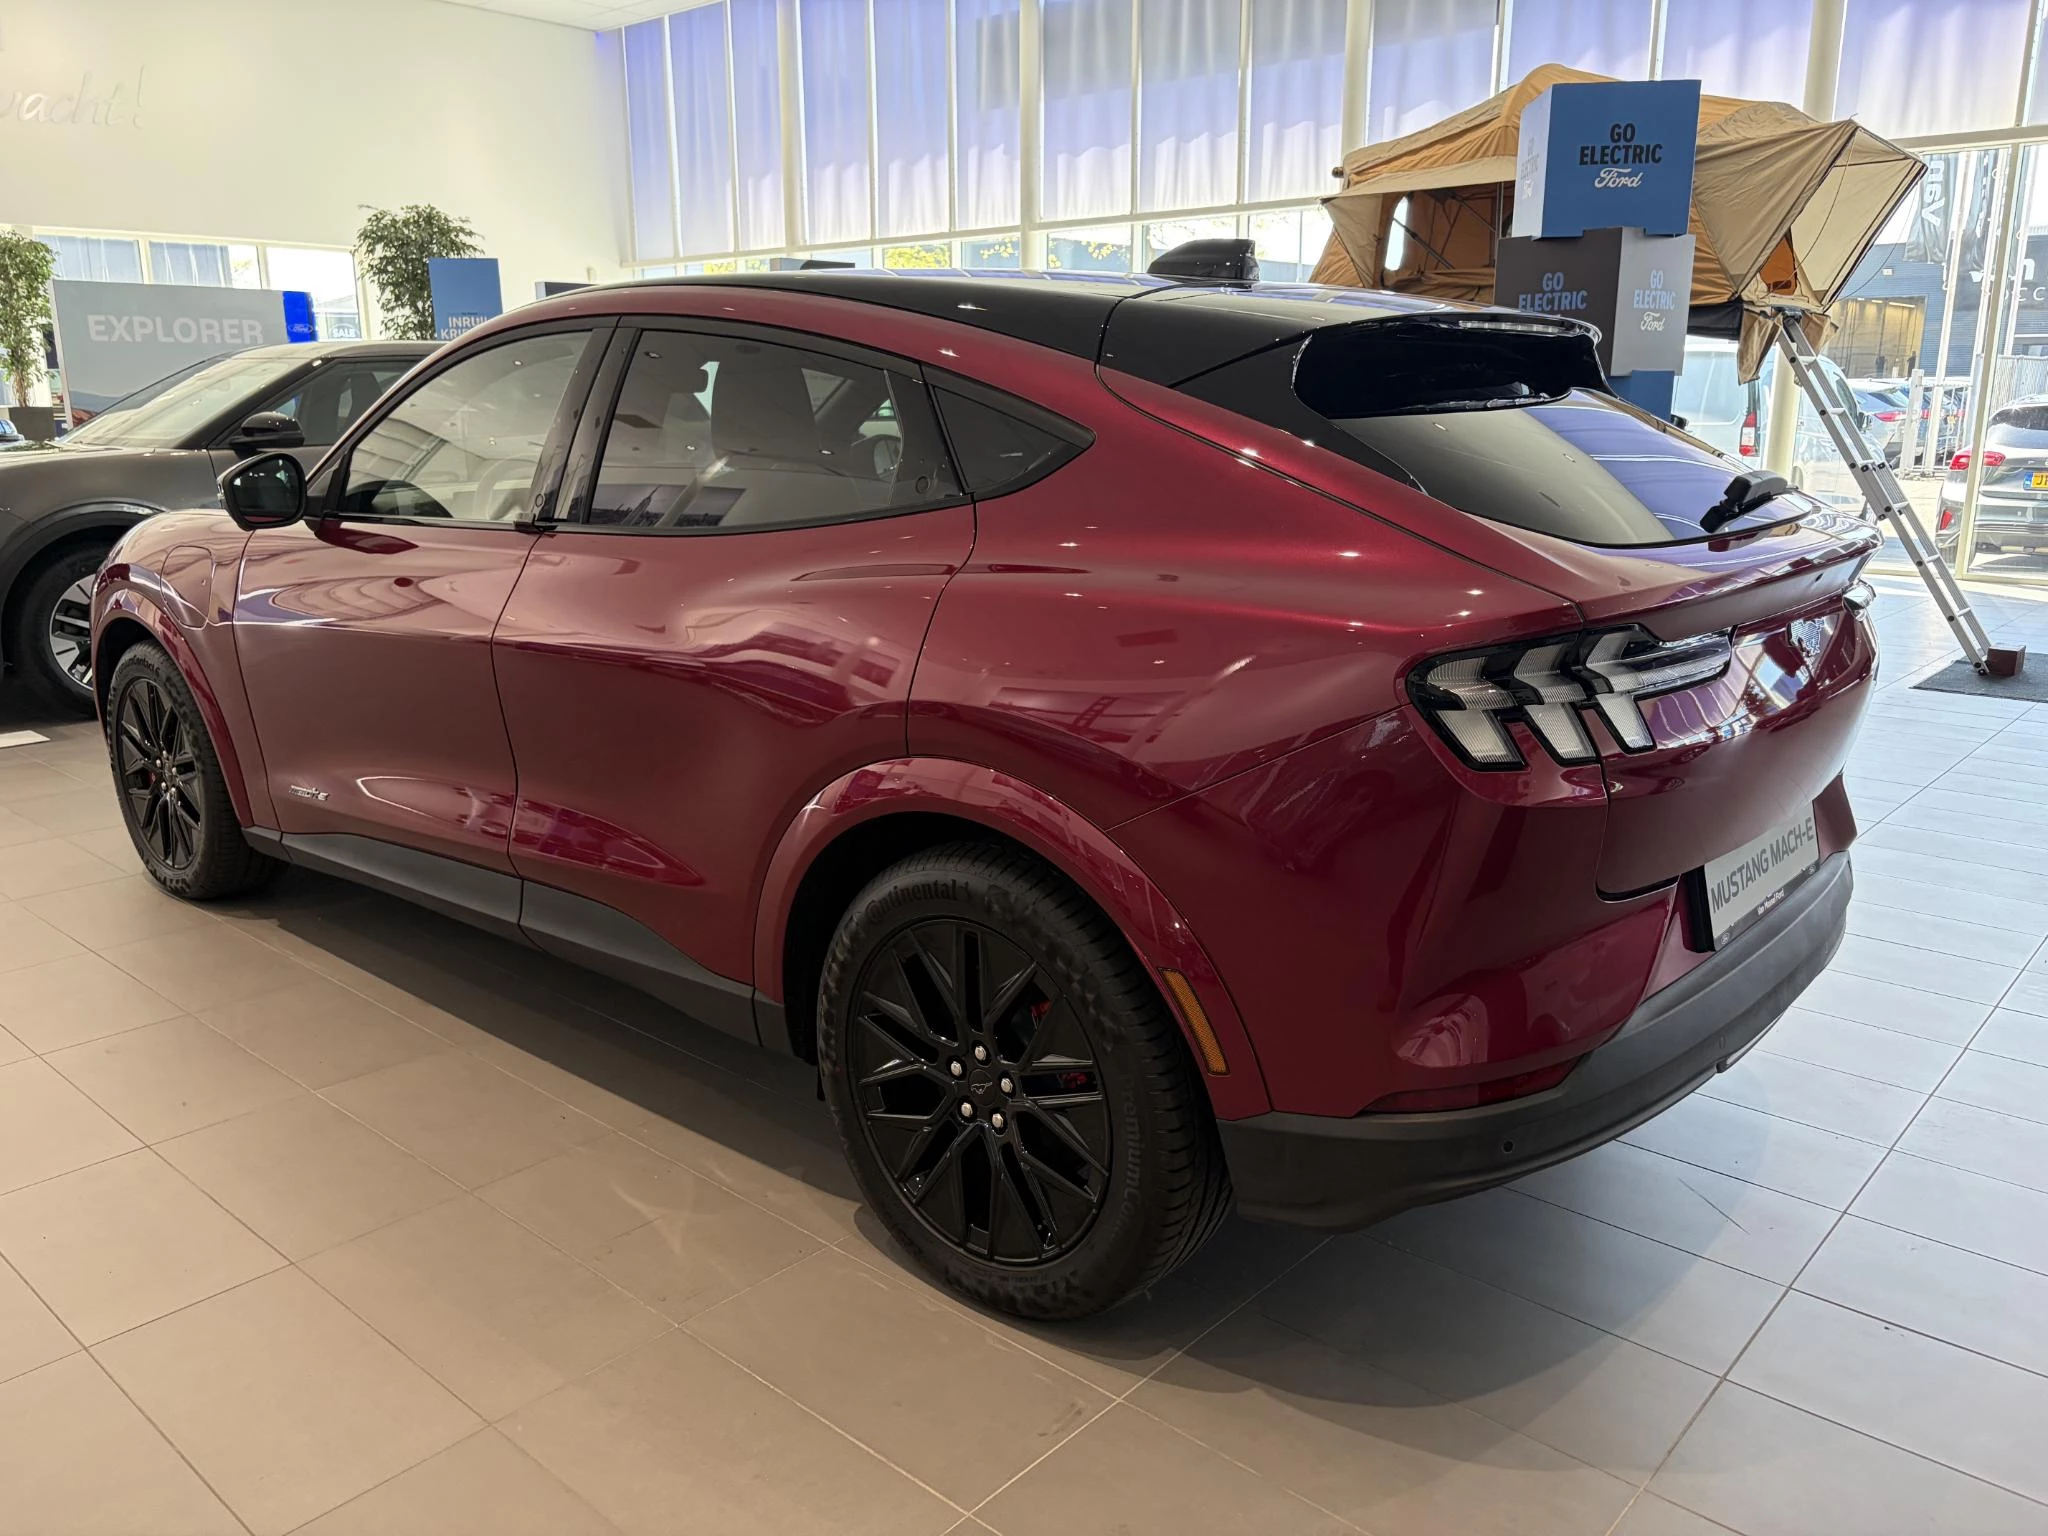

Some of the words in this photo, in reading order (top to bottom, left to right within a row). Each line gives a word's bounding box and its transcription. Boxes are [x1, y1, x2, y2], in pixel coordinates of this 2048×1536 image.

[1609, 122, 1636, 143] GO
[1579, 143, 1663, 166] ELECTRIC
[1594, 167, 1644, 188] Ford
[1542, 271, 1565, 291] GO
[1650, 269, 1664, 289] GO
[1518, 290, 1588, 312] ELECTRIC
[1633, 288, 1676, 311] ELECTRIC
[87, 314, 264, 345] EXPLORER
[1640, 311, 1666, 332] Ford
[332, 327, 356, 338] SALE
[1710, 848, 1769, 914] MUSTANG
[1769, 816, 1815, 868] MACH-E
[864, 878, 958, 926] Continental
